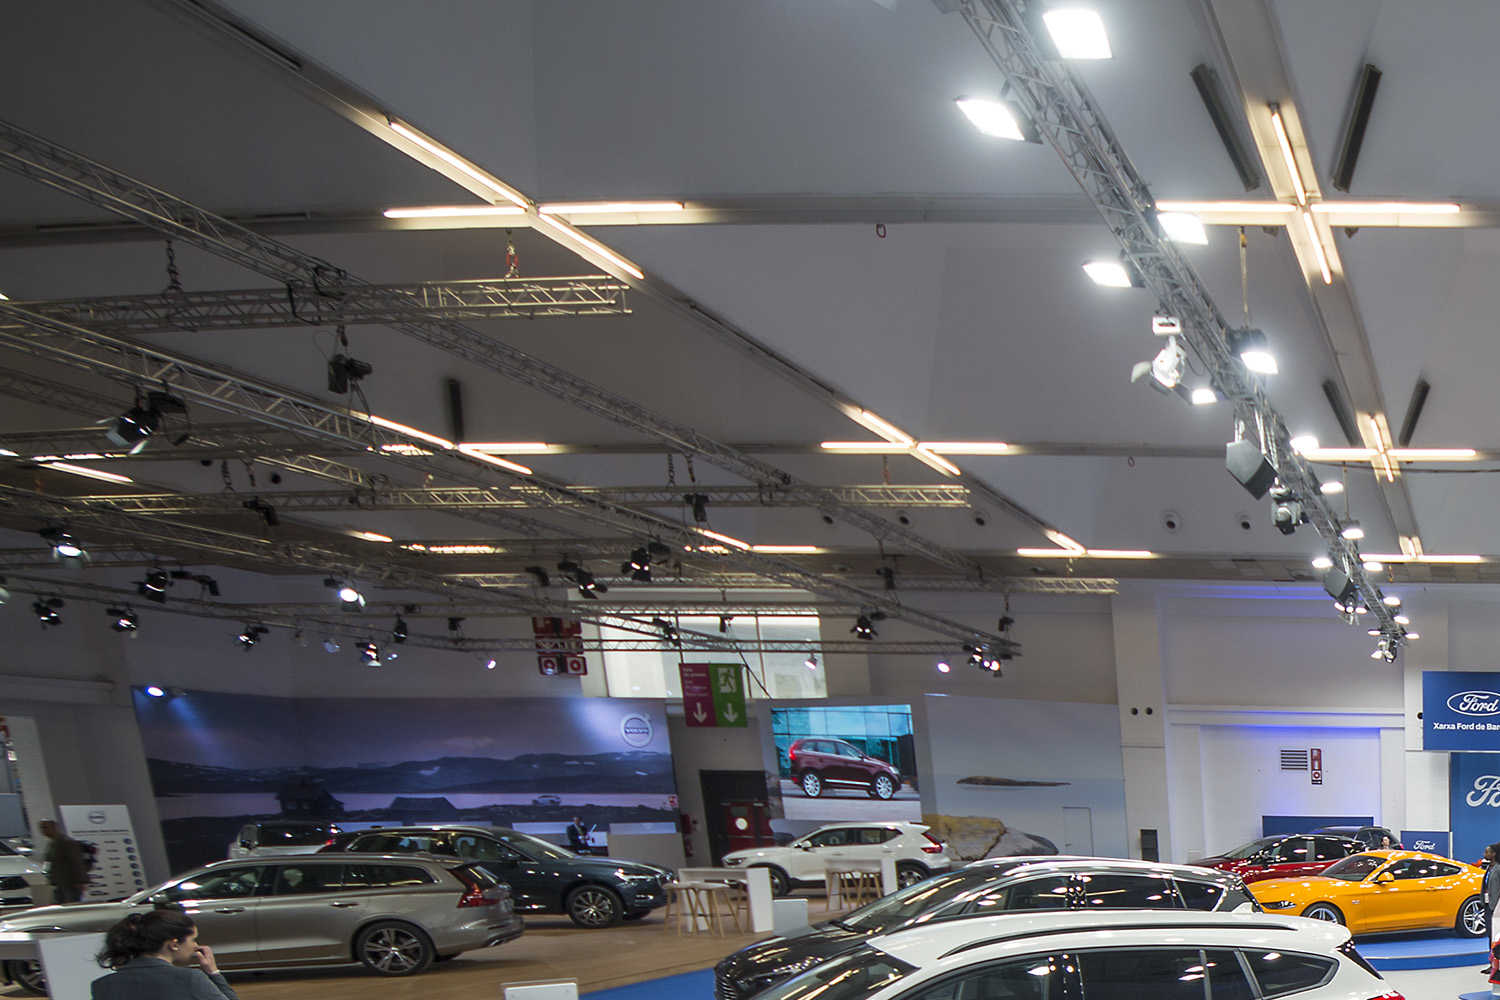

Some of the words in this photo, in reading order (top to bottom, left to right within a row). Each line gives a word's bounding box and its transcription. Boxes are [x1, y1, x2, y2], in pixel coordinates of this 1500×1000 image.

[1459, 693, 1499, 712] Ford
[1433, 722, 1456, 731] Xarxa
[1456, 722, 1475, 731] Ford
[1475, 722, 1486, 731] de
[1413, 840, 1436, 850] Ford
